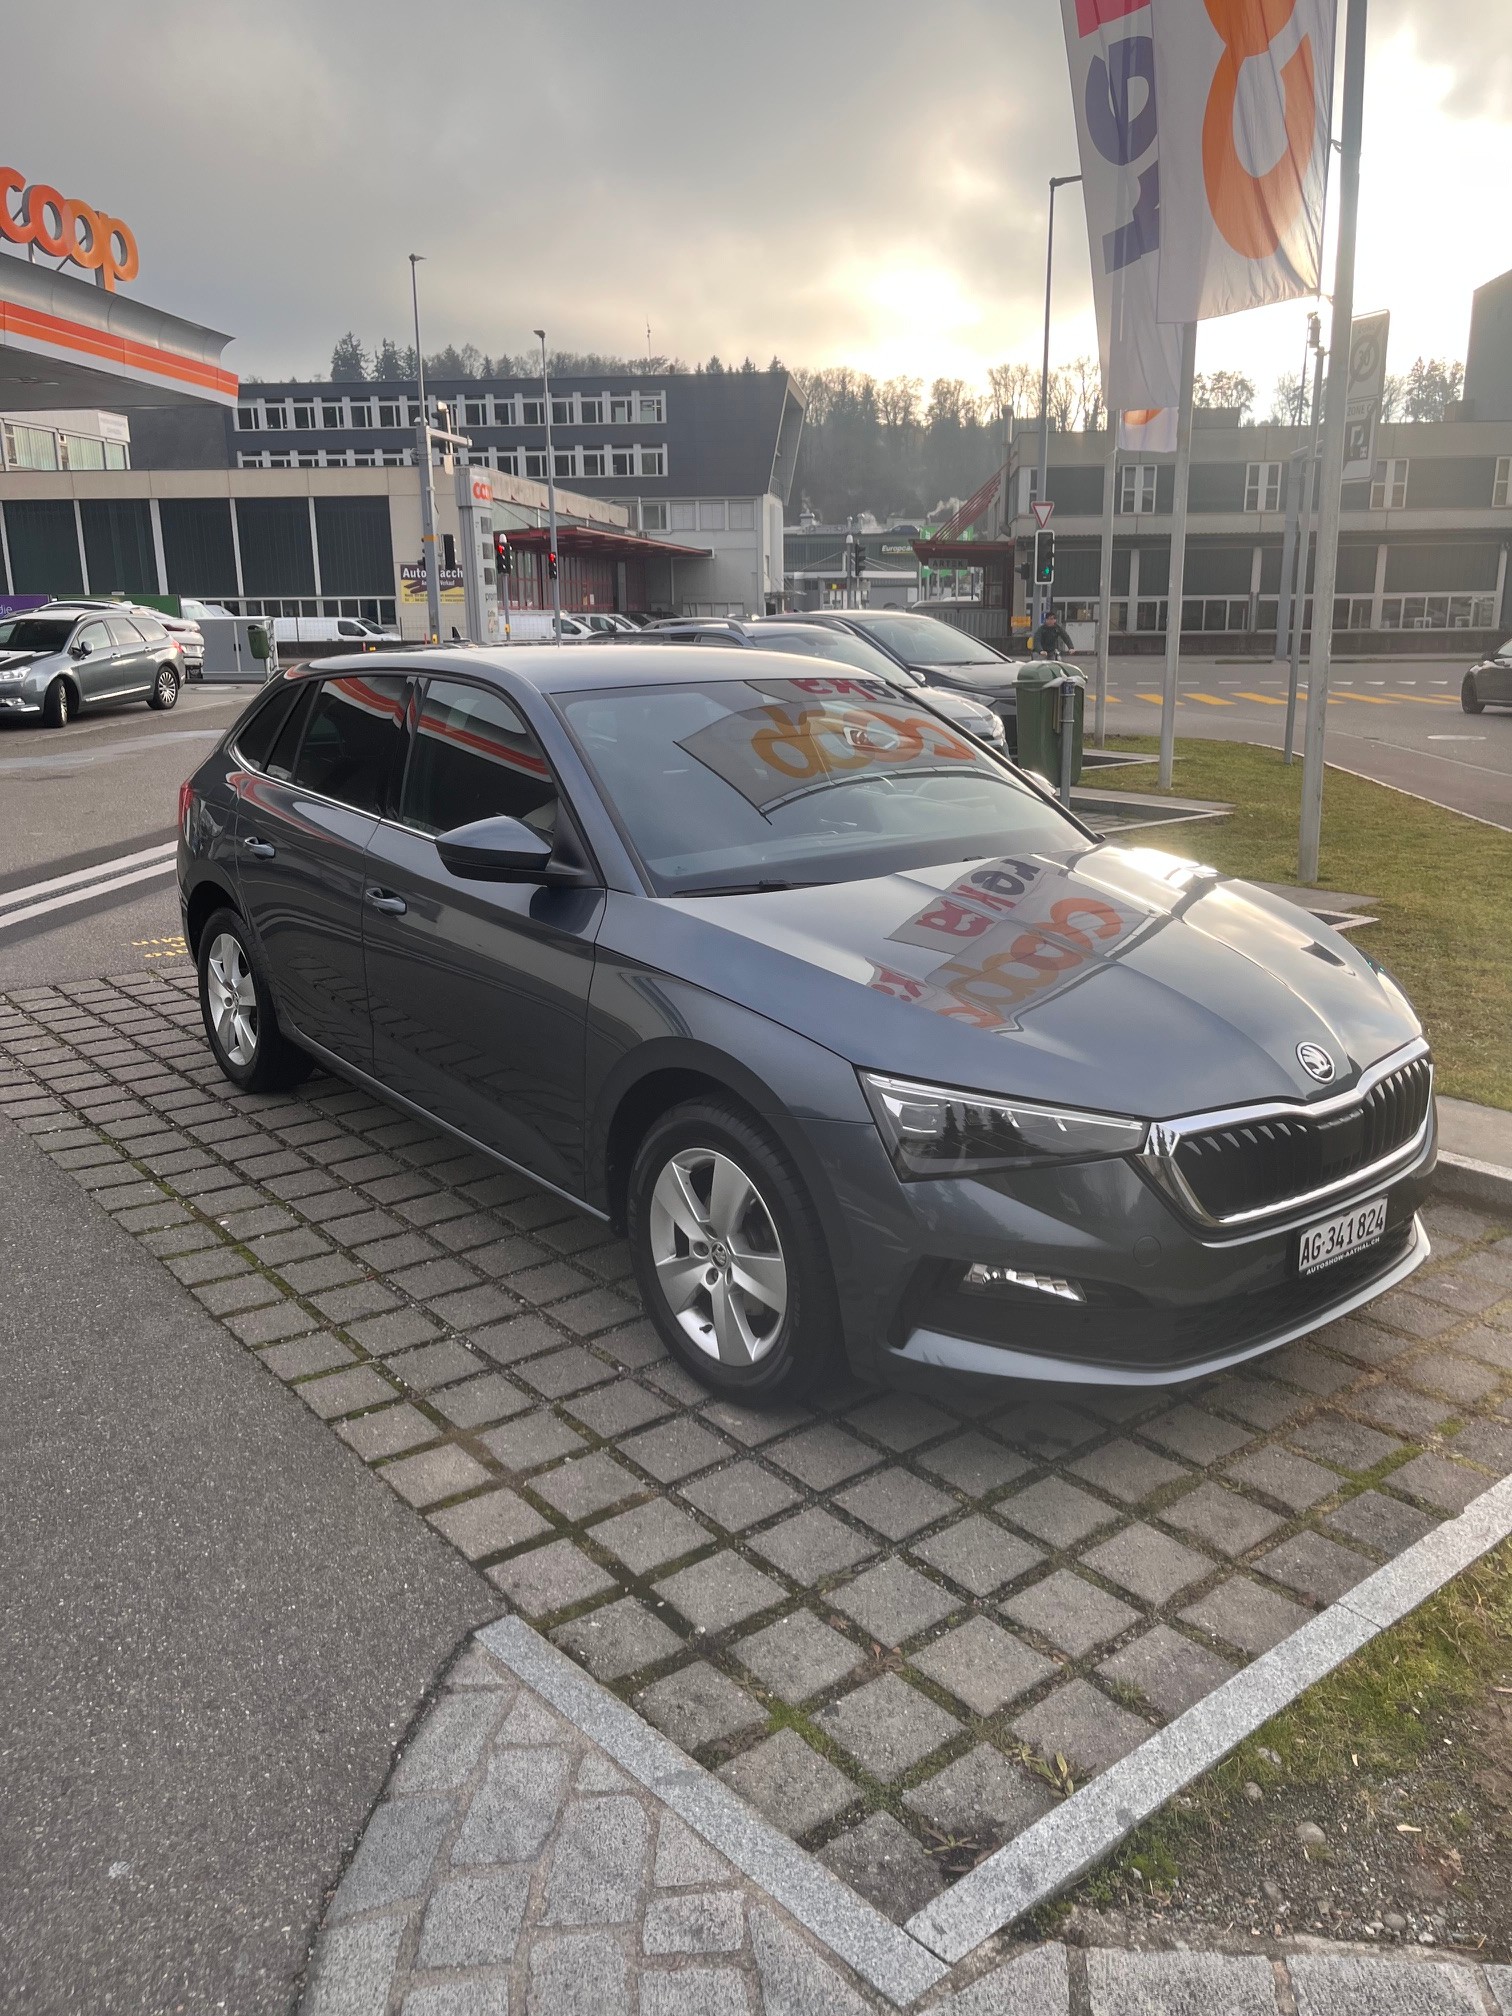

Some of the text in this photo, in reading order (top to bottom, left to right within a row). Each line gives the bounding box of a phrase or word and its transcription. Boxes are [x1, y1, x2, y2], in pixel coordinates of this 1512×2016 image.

[0, 166, 139, 293] coop
[882, 544, 913, 552] Europca
[402, 567, 427, 578] Auto
